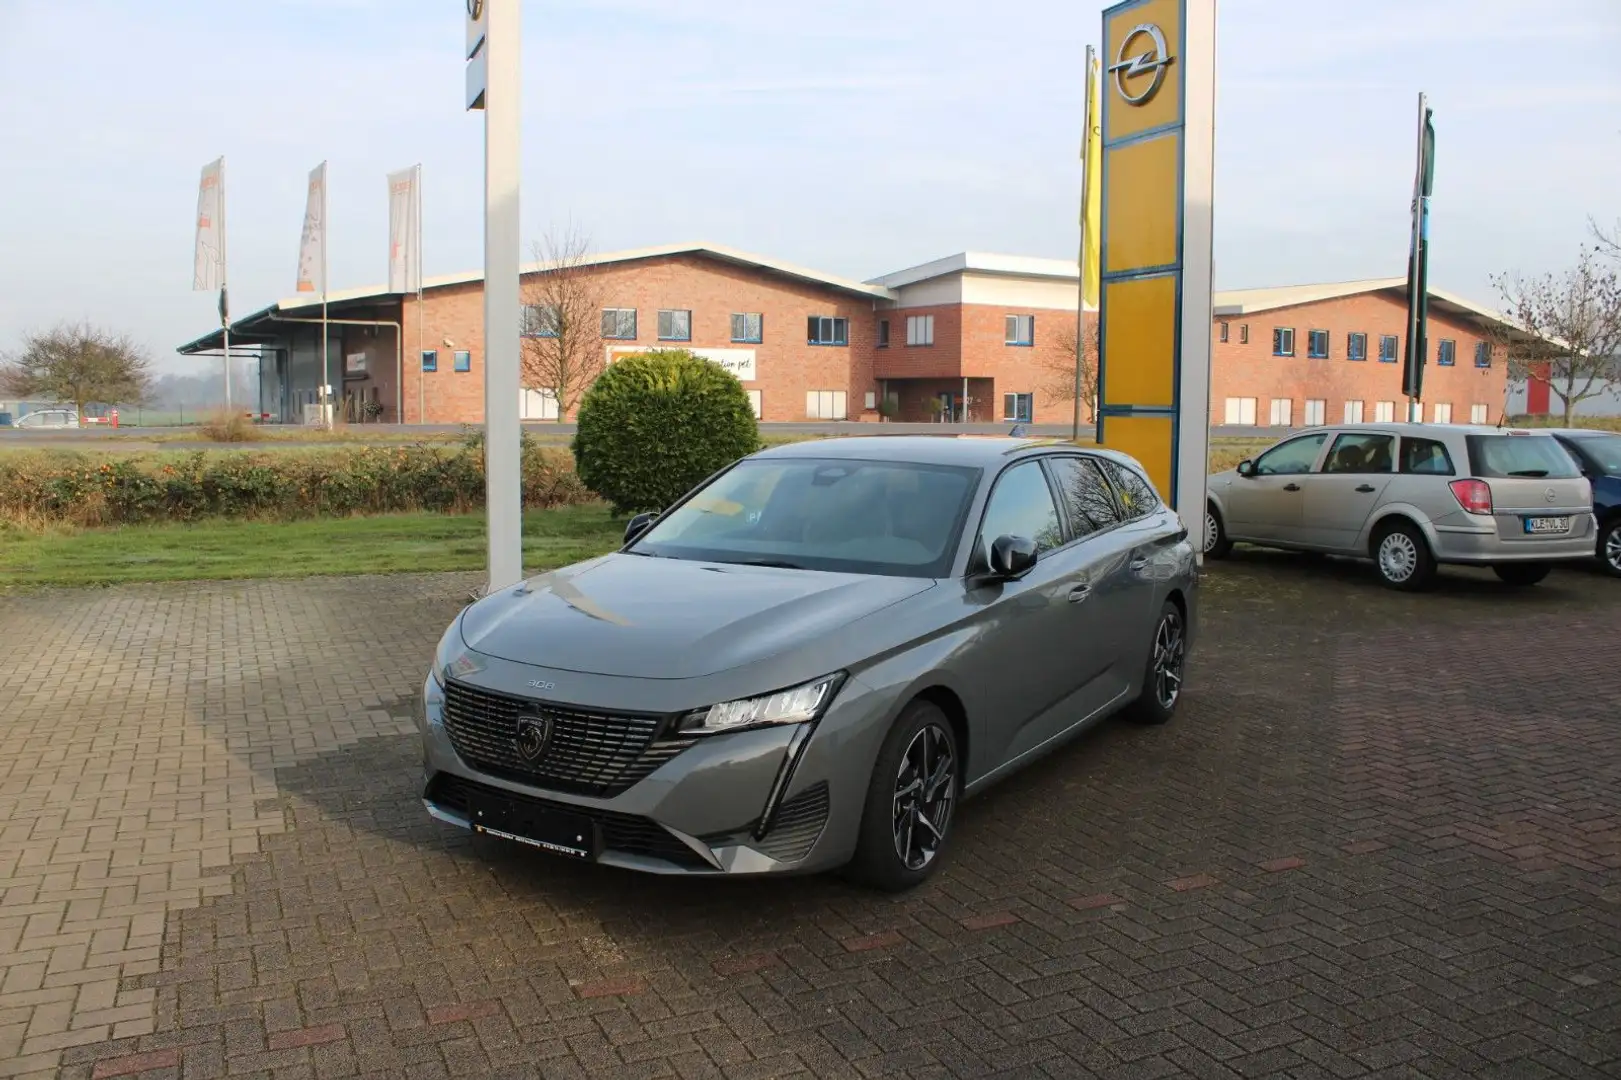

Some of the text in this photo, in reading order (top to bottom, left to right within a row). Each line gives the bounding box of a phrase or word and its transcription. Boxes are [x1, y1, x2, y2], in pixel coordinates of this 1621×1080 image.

[1531, 519, 1545, 529] KLE
[1549, 518, 1558, 529] VL
[528, 679, 555, 689] 308
